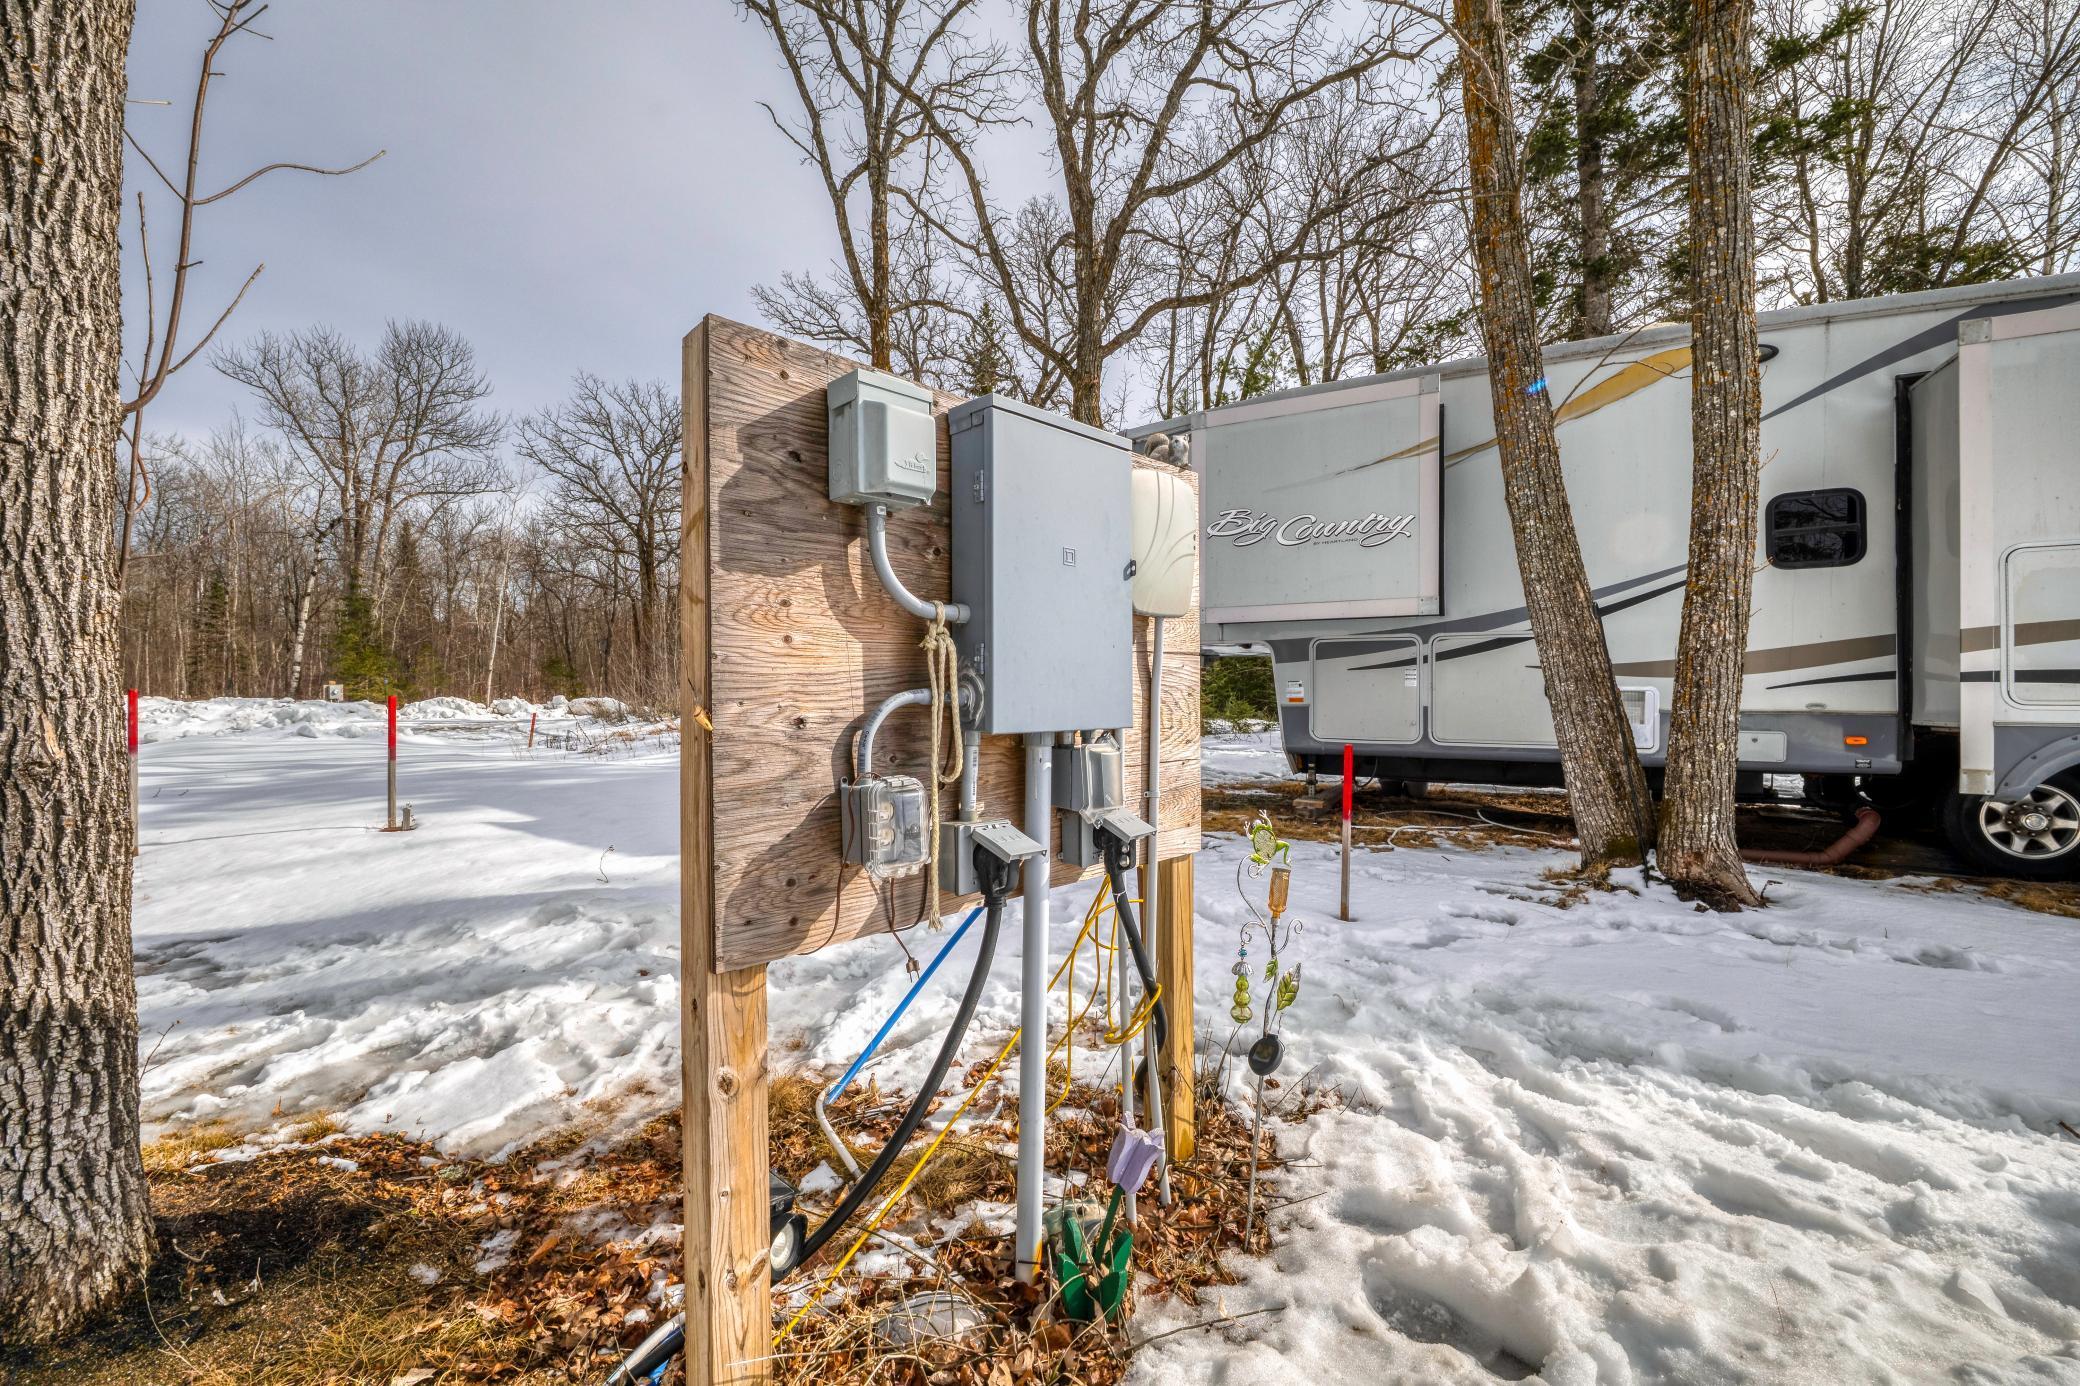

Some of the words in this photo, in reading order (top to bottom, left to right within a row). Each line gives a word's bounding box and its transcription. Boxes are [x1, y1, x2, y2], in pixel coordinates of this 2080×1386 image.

[1206, 509, 1278, 547] Big
[1275, 512, 1416, 547] Country
[1321, 537, 1359, 545] HEARTLAND
